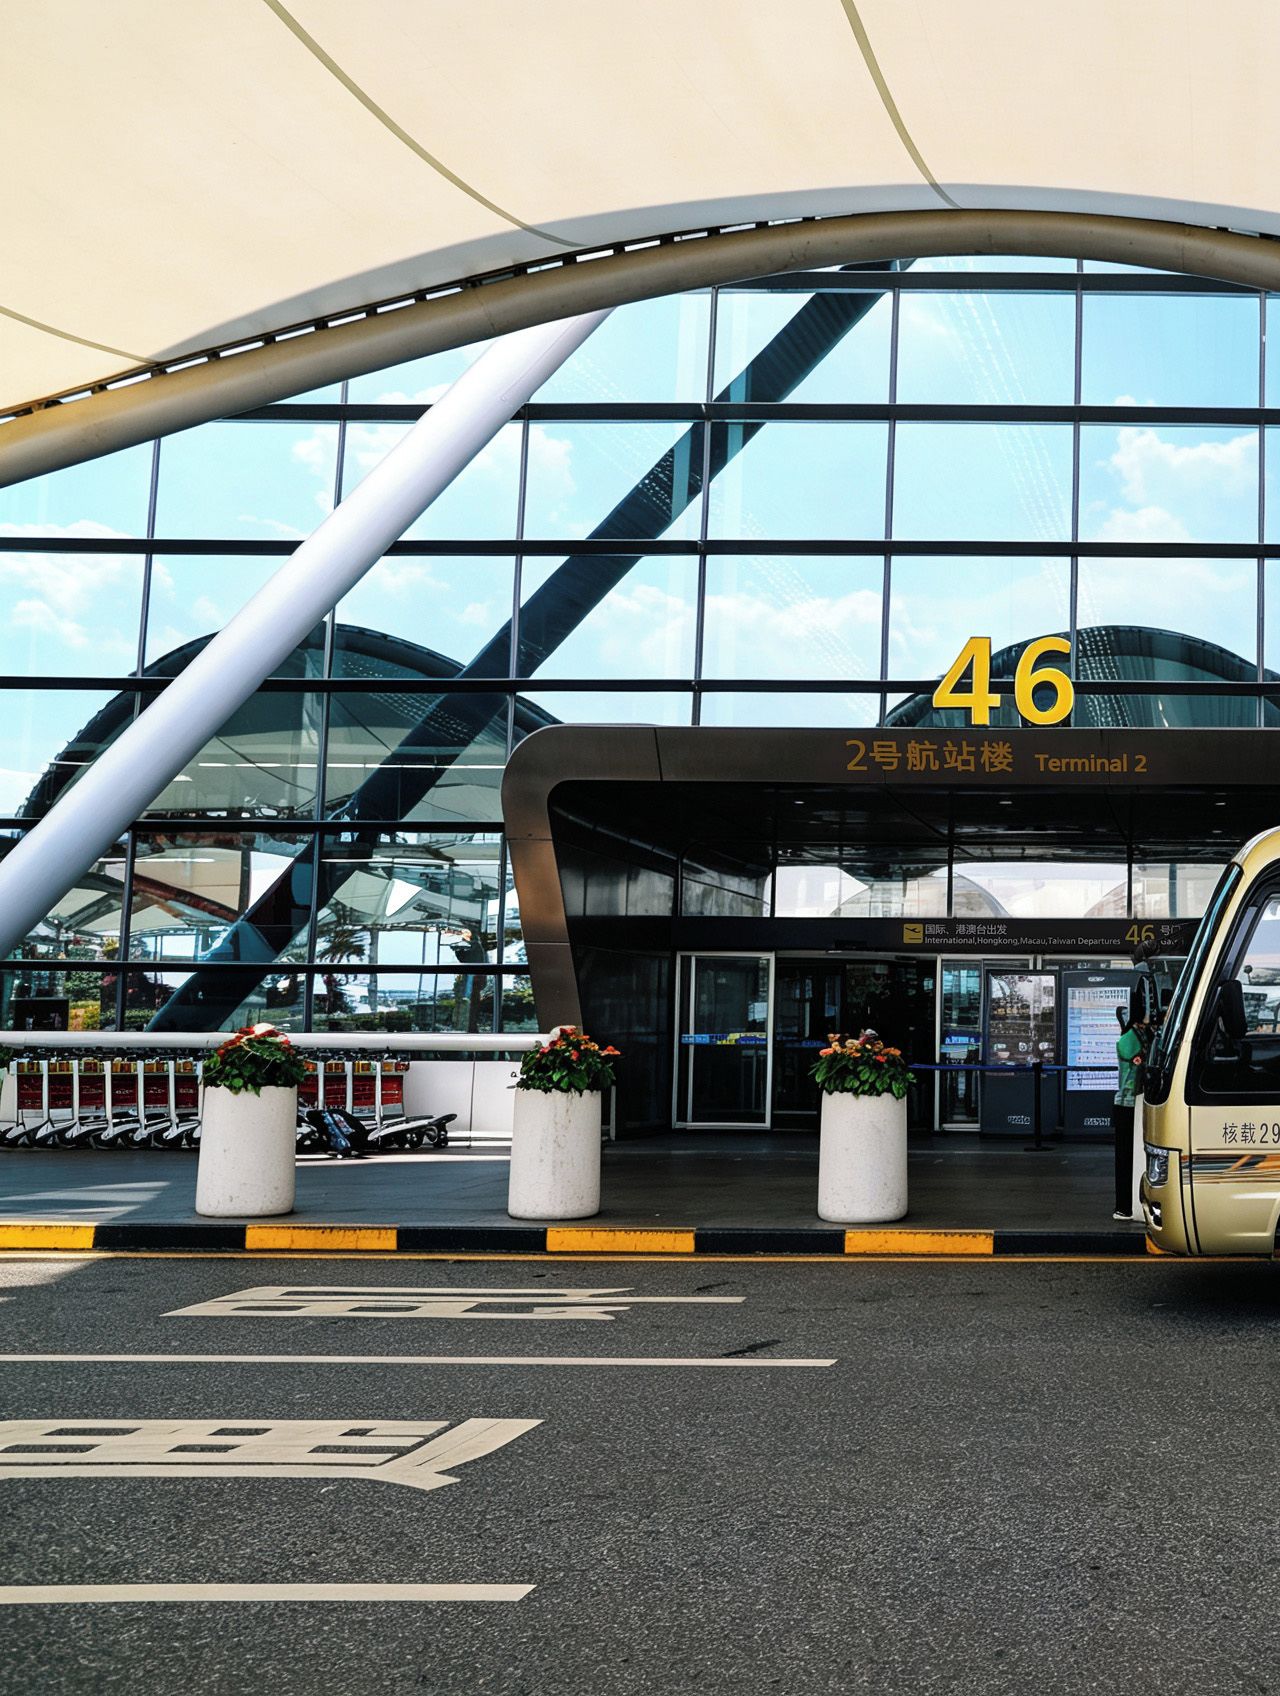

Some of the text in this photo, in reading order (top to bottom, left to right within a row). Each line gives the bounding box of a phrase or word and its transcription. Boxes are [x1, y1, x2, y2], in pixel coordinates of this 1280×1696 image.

[932, 636, 1075, 726] 46
[845, 739, 1014, 773] 2号航站楼
[1034, 753, 1148, 773] Terminal 2
[1077, 936, 1121, 946] Departures
[1124, 924, 1156, 945] 46
